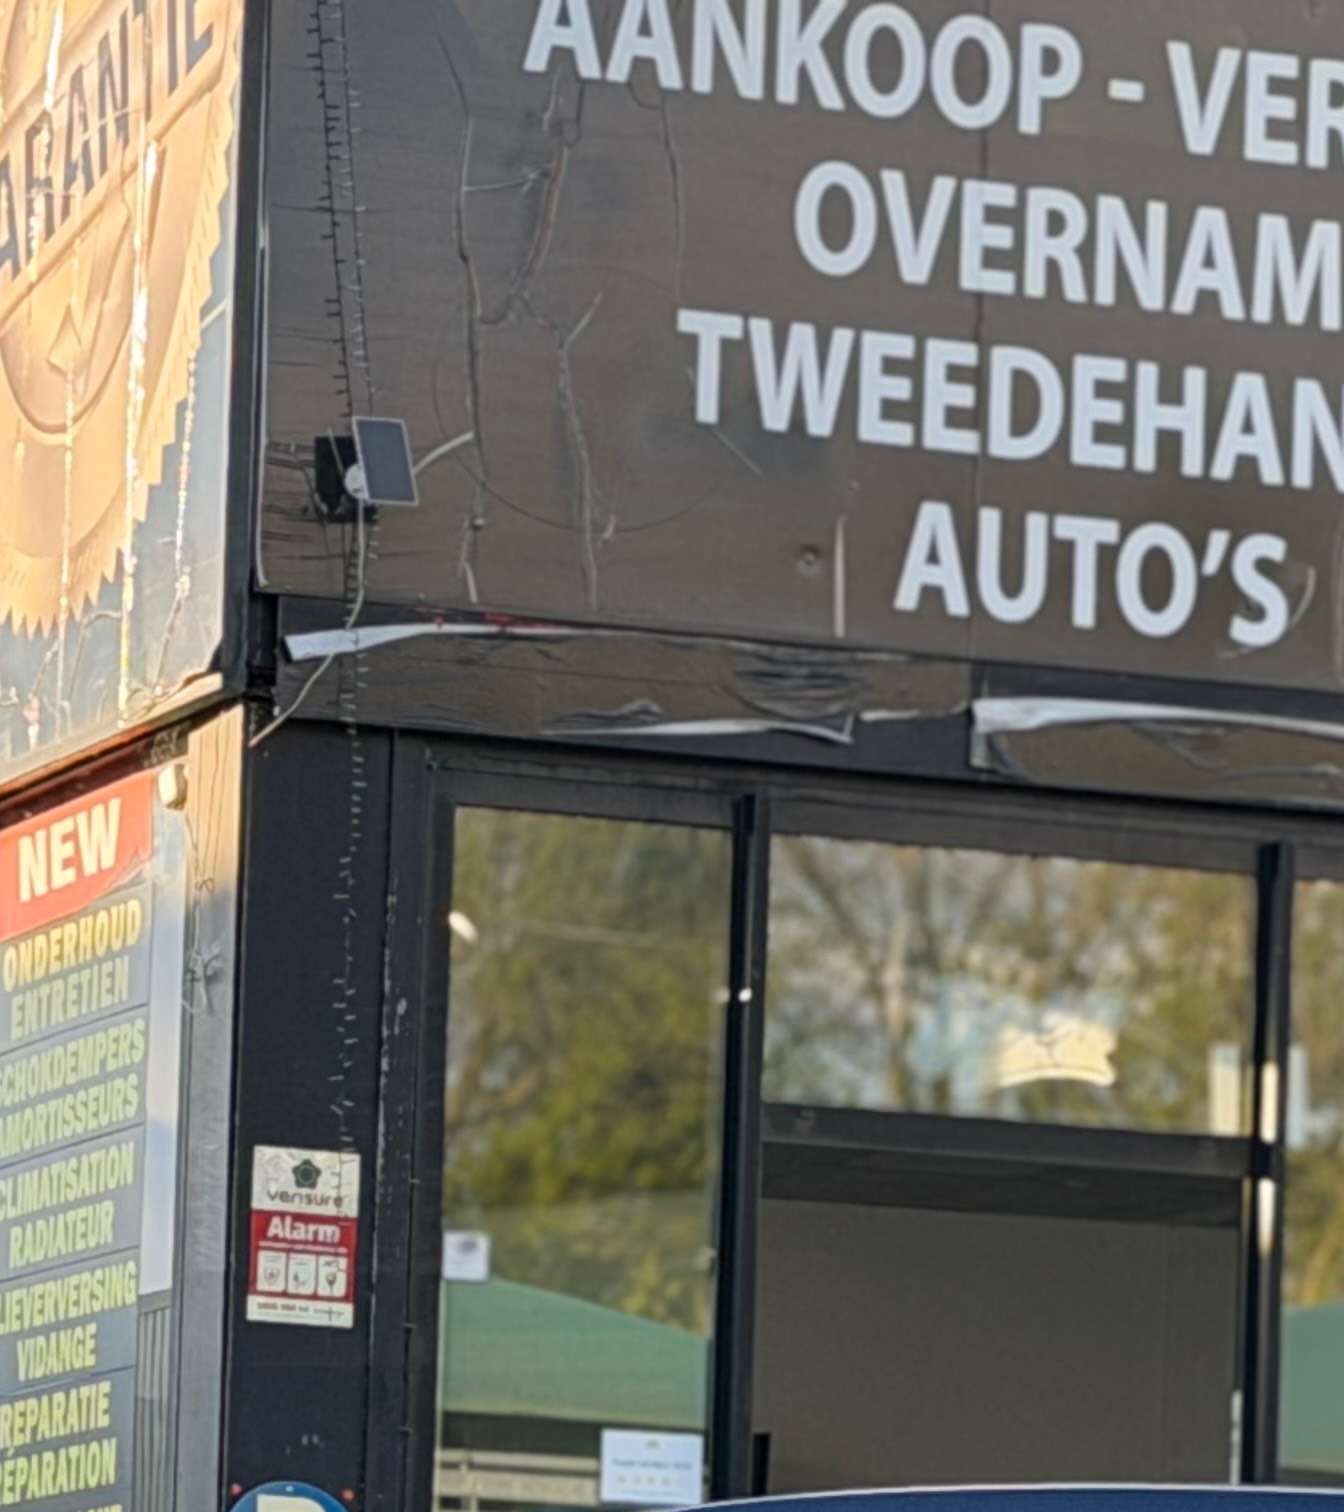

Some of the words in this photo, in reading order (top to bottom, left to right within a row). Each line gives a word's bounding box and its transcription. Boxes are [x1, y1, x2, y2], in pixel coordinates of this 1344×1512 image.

[523, 0, 1082, 134] AANKOOP
[894, 501, 1288, 647] AUTO'S
[18, 798, 121, 904] NEW
[2, 898, 142, 993] ONDERHOUD
[9, 955, 130, 1041] ENTRETIEN
[9, 1202, 114, 1270] RADIATEUR
[267, 1215, 341, 1244] Alarm
[16, 1322, 97, 1382] VIDANGE
